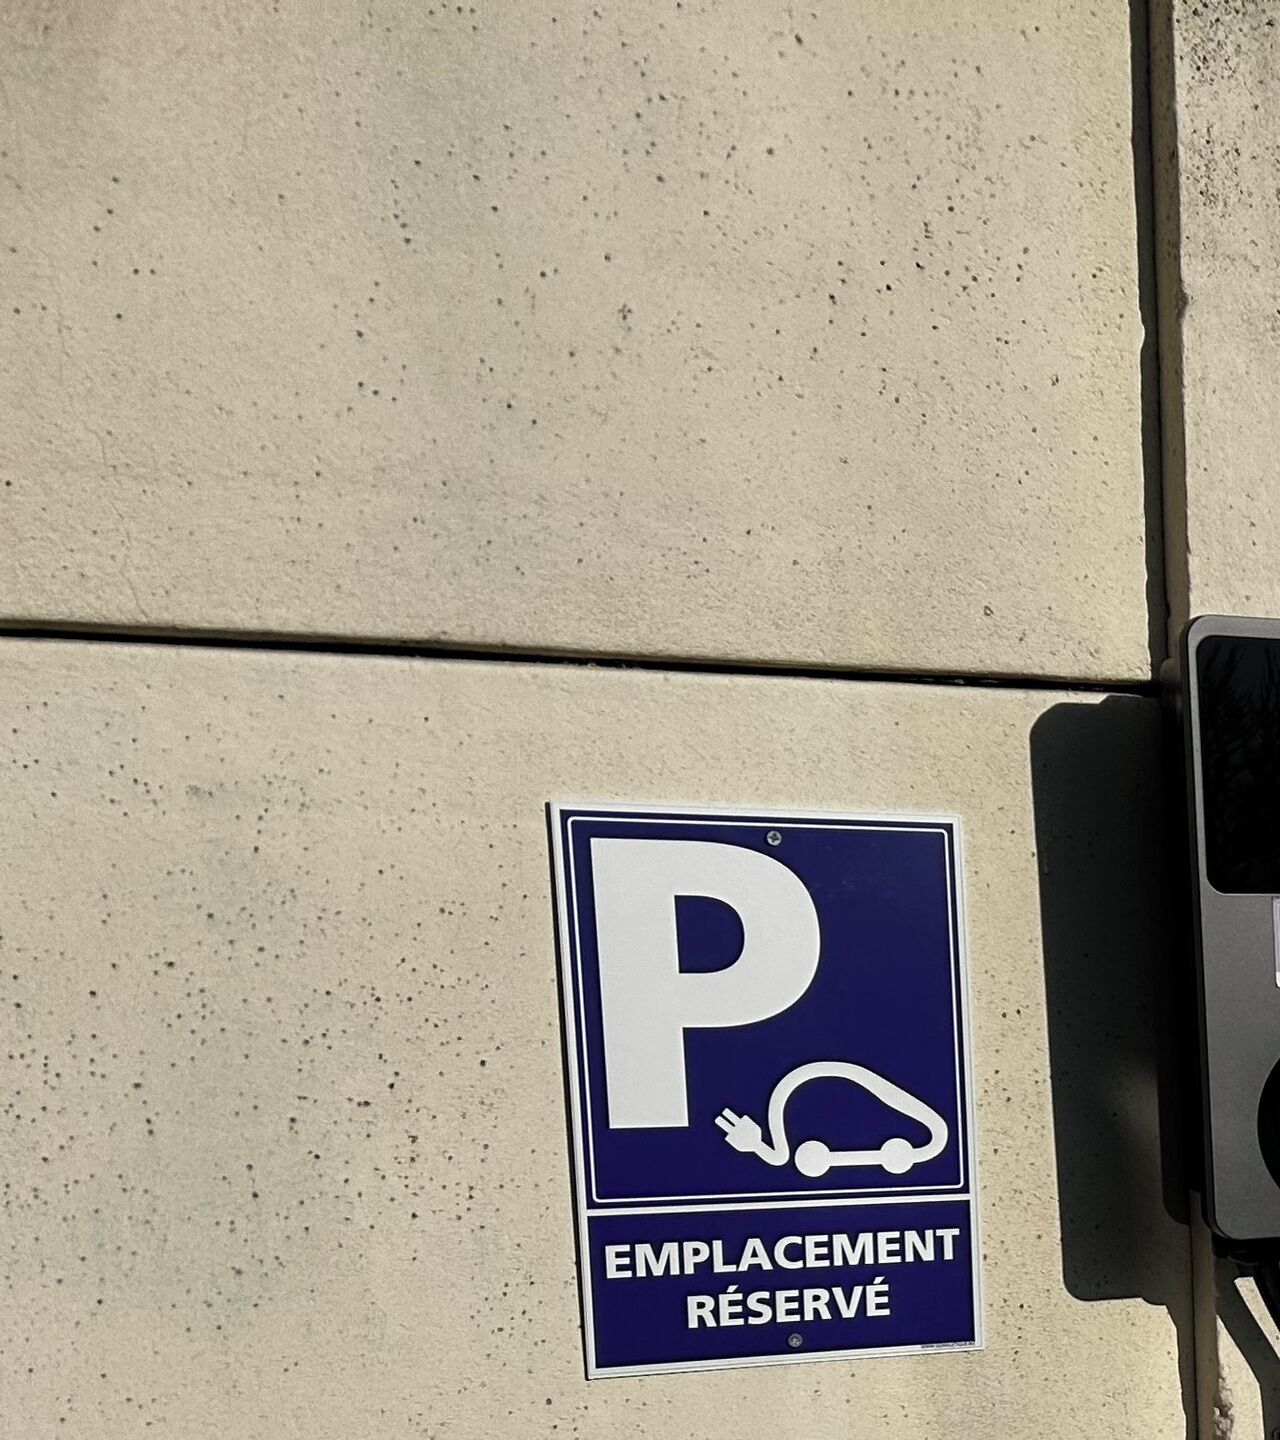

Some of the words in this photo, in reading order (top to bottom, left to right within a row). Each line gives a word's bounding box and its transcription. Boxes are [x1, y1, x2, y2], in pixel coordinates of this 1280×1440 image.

[590, 837, 822, 1129] P
[605, 1228, 960, 1279] EMPLACEMENT
[687, 1276, 891, 1329] RÉSERVÉ
